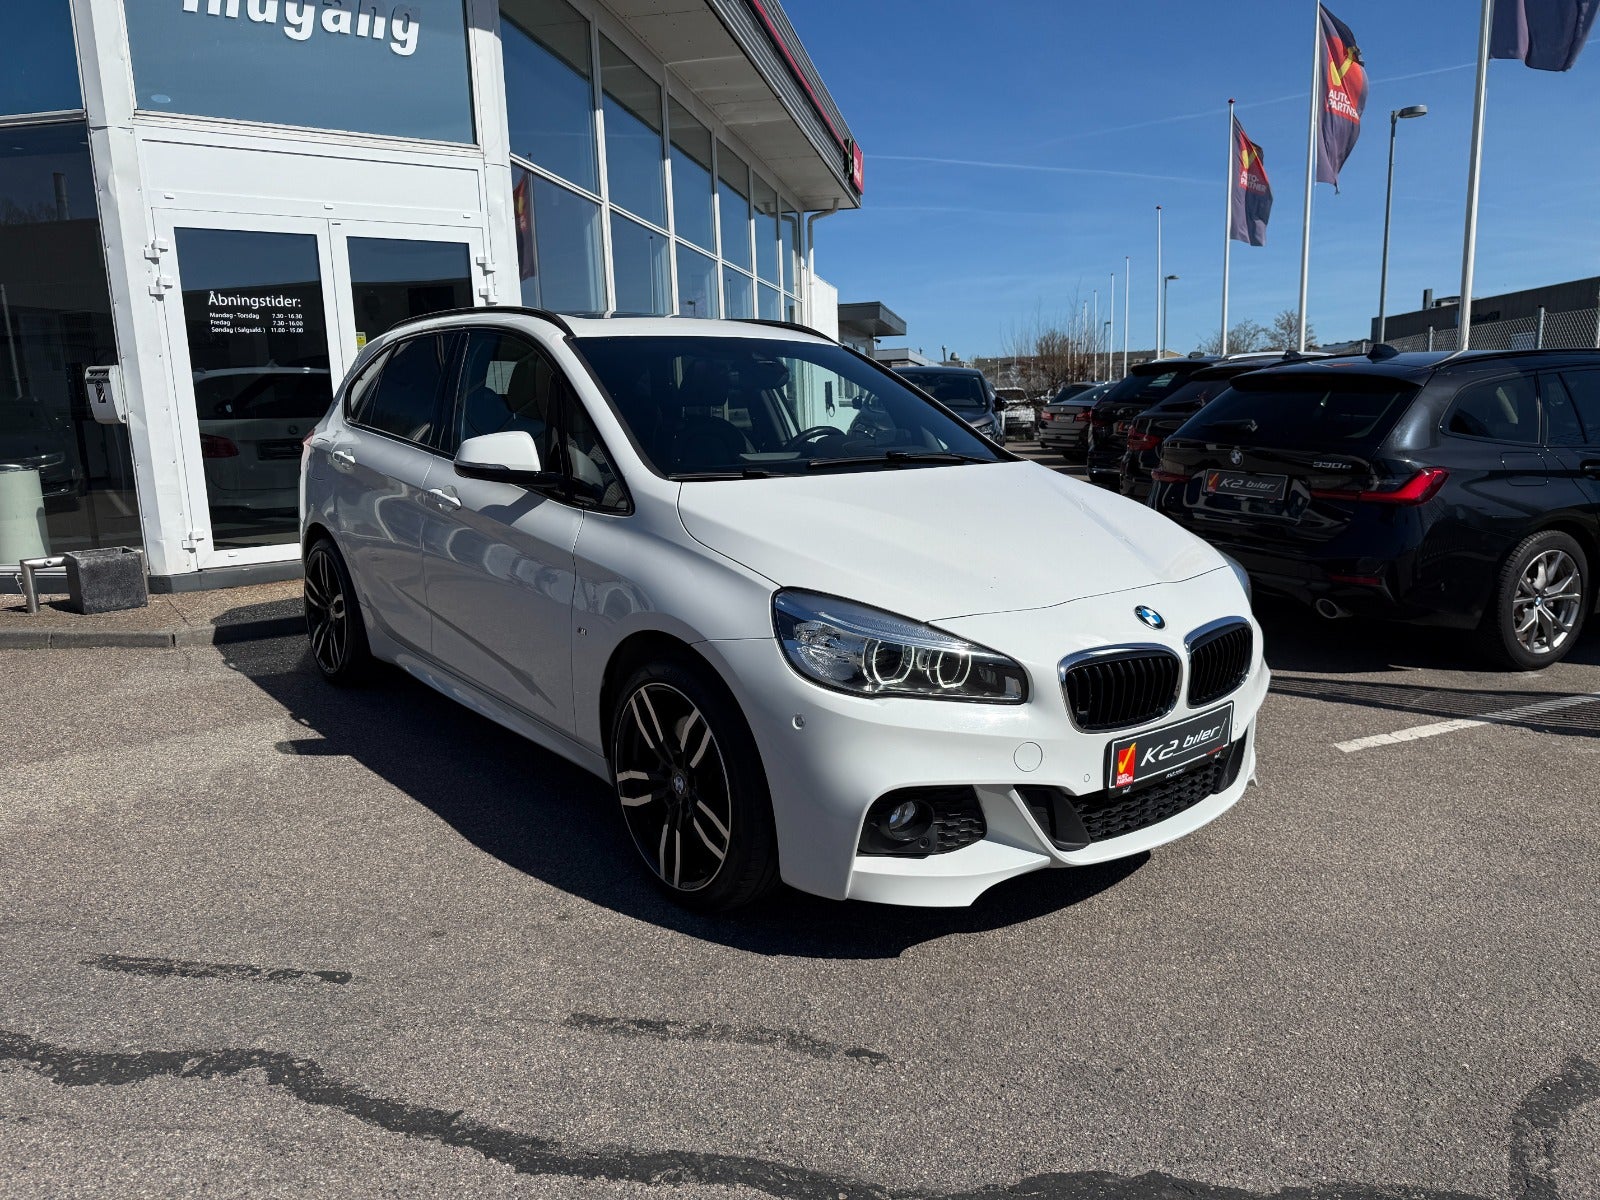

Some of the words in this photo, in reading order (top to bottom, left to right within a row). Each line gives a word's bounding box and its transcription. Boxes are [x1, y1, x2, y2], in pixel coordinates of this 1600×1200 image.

[183, 0, 419, 56] gang
[208, 290, 302, 309] Åbningstider:
[1219, 478, 1243, 489] K2
[1246, 480, 1276, 490] biler
[1140, 740, 1179, 767] K2
[1182, 725, 1220, 748] biler
